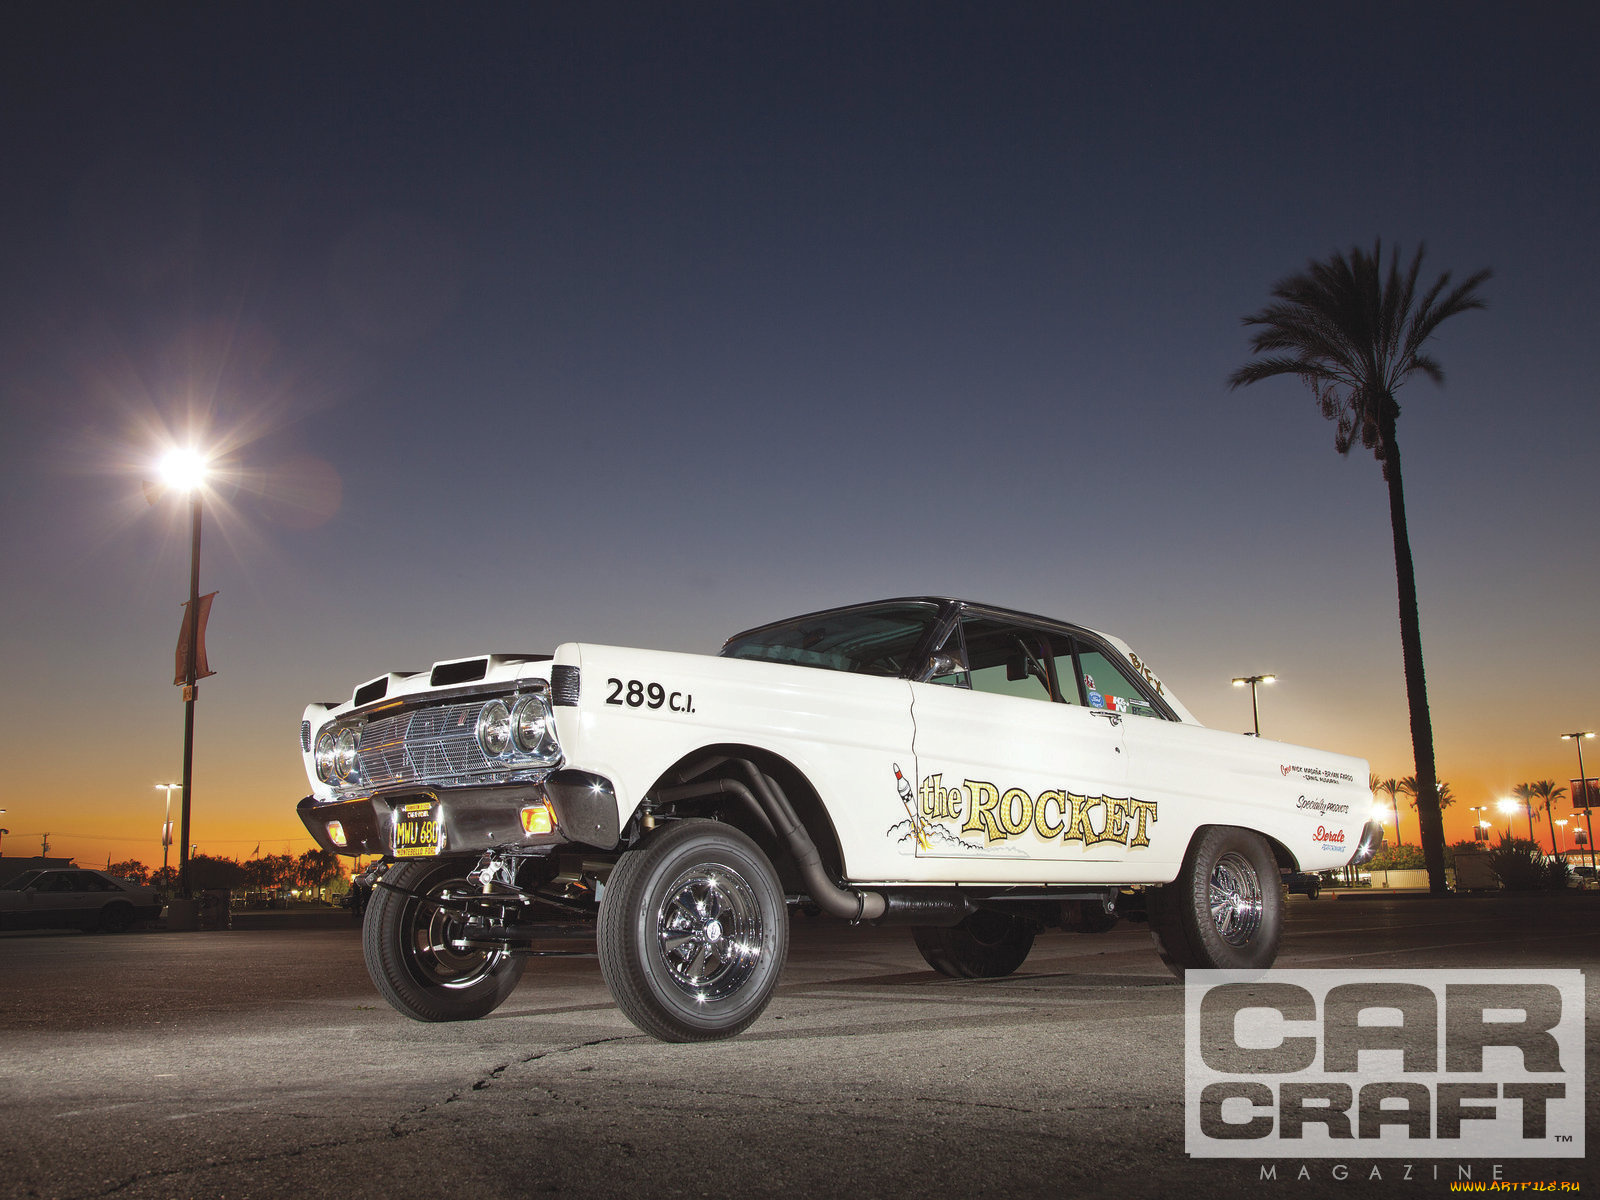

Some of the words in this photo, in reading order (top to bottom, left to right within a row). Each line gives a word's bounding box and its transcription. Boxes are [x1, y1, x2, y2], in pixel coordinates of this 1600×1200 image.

[606, 678, 665, 709] 289
[669, 691, 696, 713] C.I.
[920, 773, 962, 819] the
[961, 778, 1157, 848] ROCKET
[1296, 795, 1327, 816] Specialty
[397, 821, 418, 845] MWU
[420, 821, 438, 844] 680
